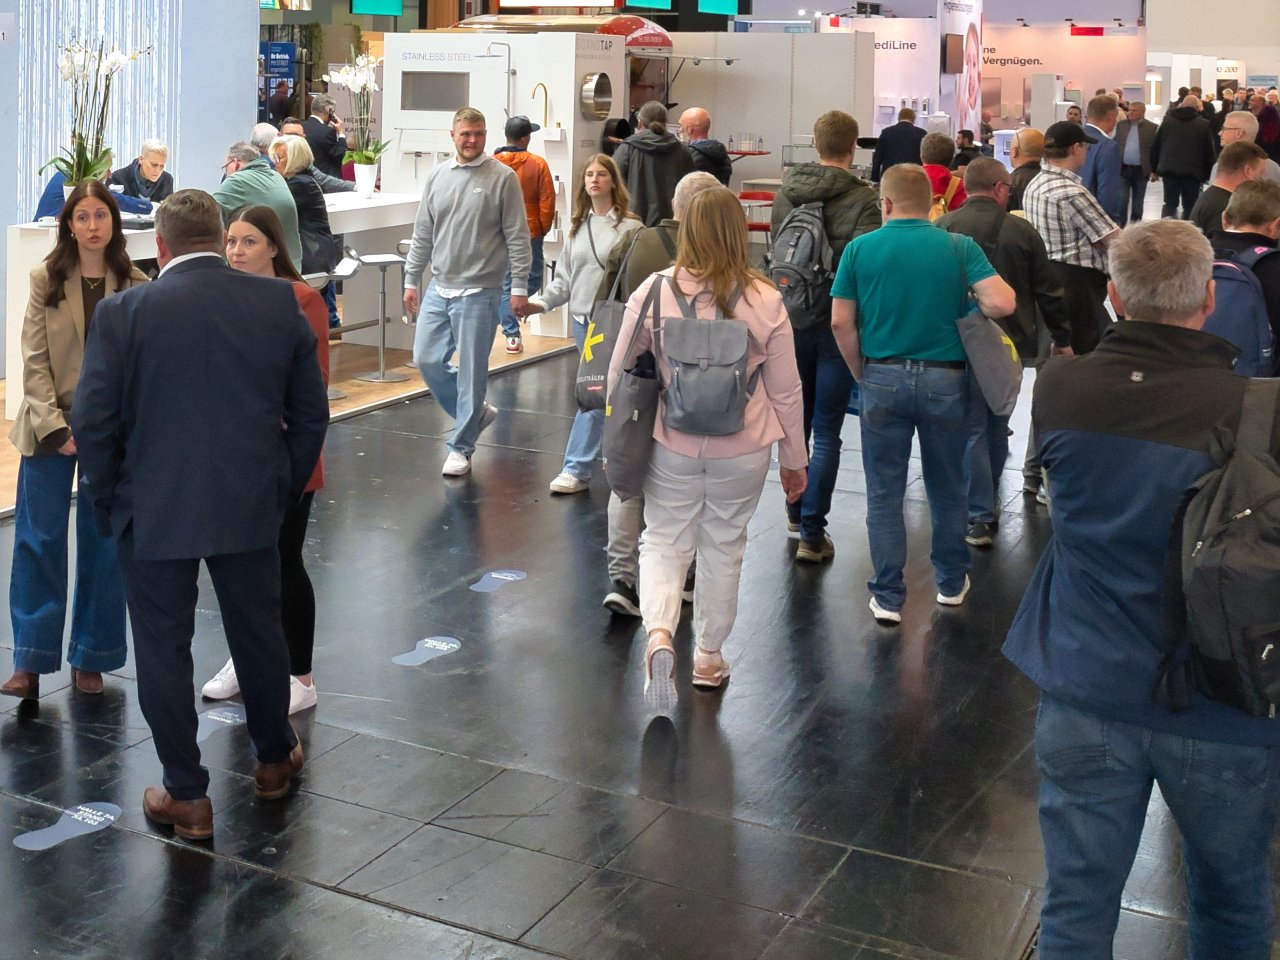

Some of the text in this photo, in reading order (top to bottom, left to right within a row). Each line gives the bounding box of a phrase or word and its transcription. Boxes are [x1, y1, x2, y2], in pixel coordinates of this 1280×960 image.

[402, 52, 473, 61] STAINLESS STEEL
[982, 56, 1043, 67] Vergnügen.
